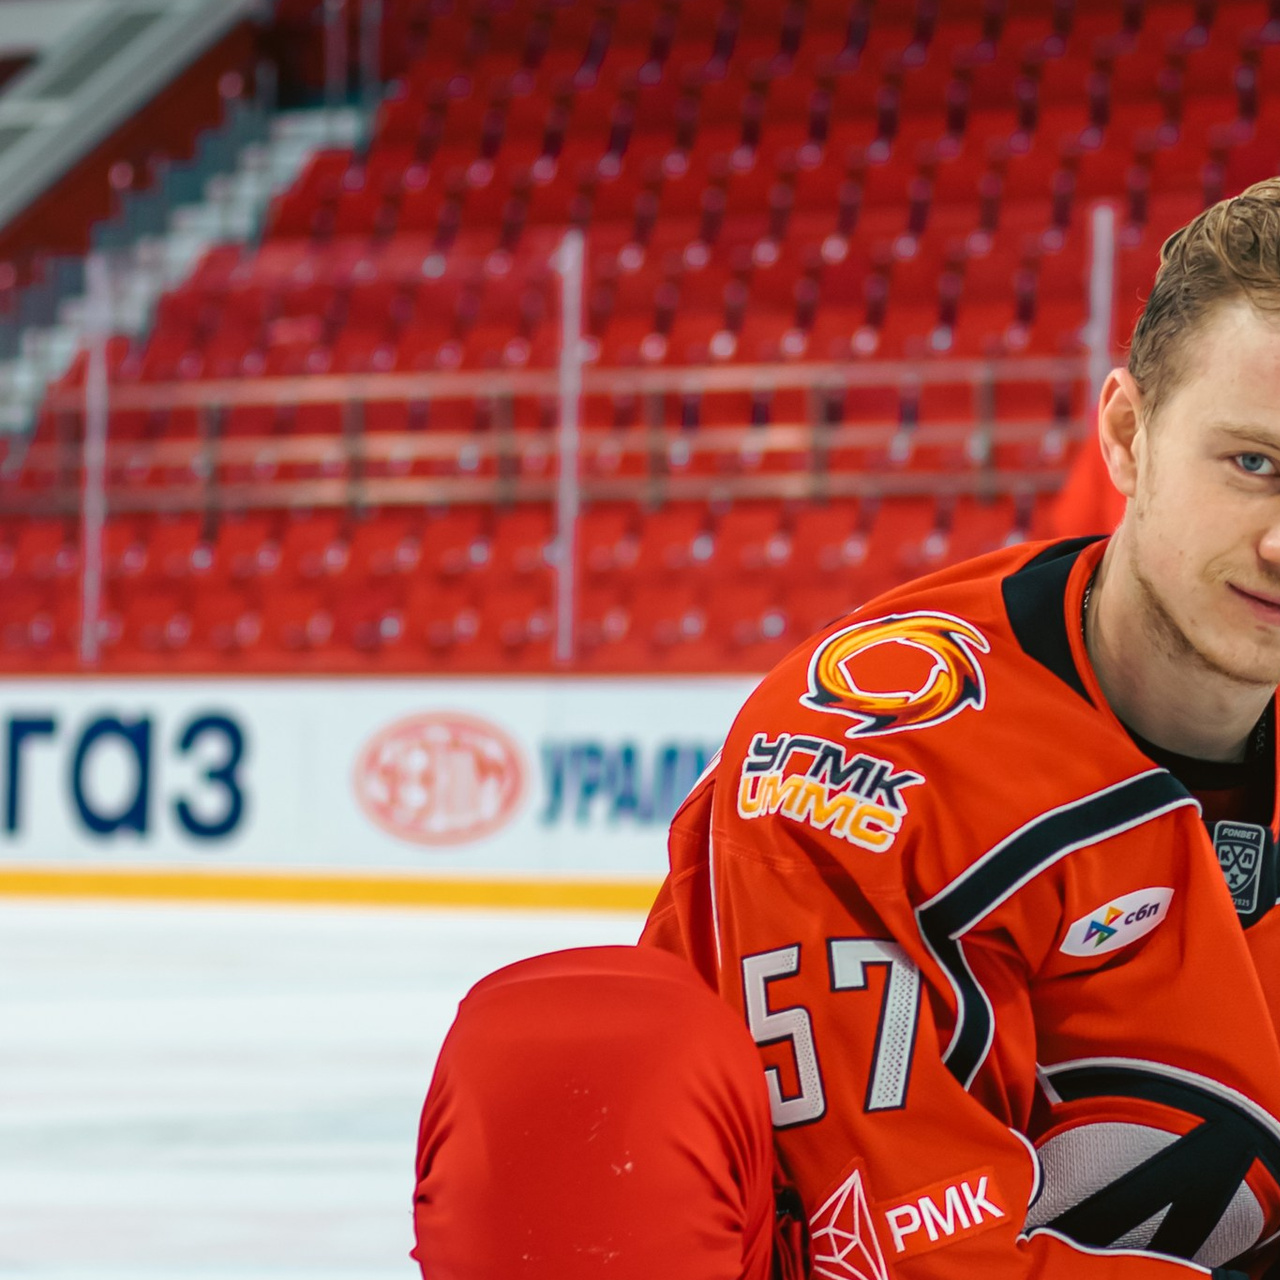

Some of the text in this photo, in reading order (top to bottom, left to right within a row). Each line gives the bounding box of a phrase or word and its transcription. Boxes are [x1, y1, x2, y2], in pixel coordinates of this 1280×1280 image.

[740, 773, 898, 850] UMMC
[744, 734, 923, 812] УГМК
[1222, 827, 1259, 841] FONBET
[741, 937, 921, 1131] 57
